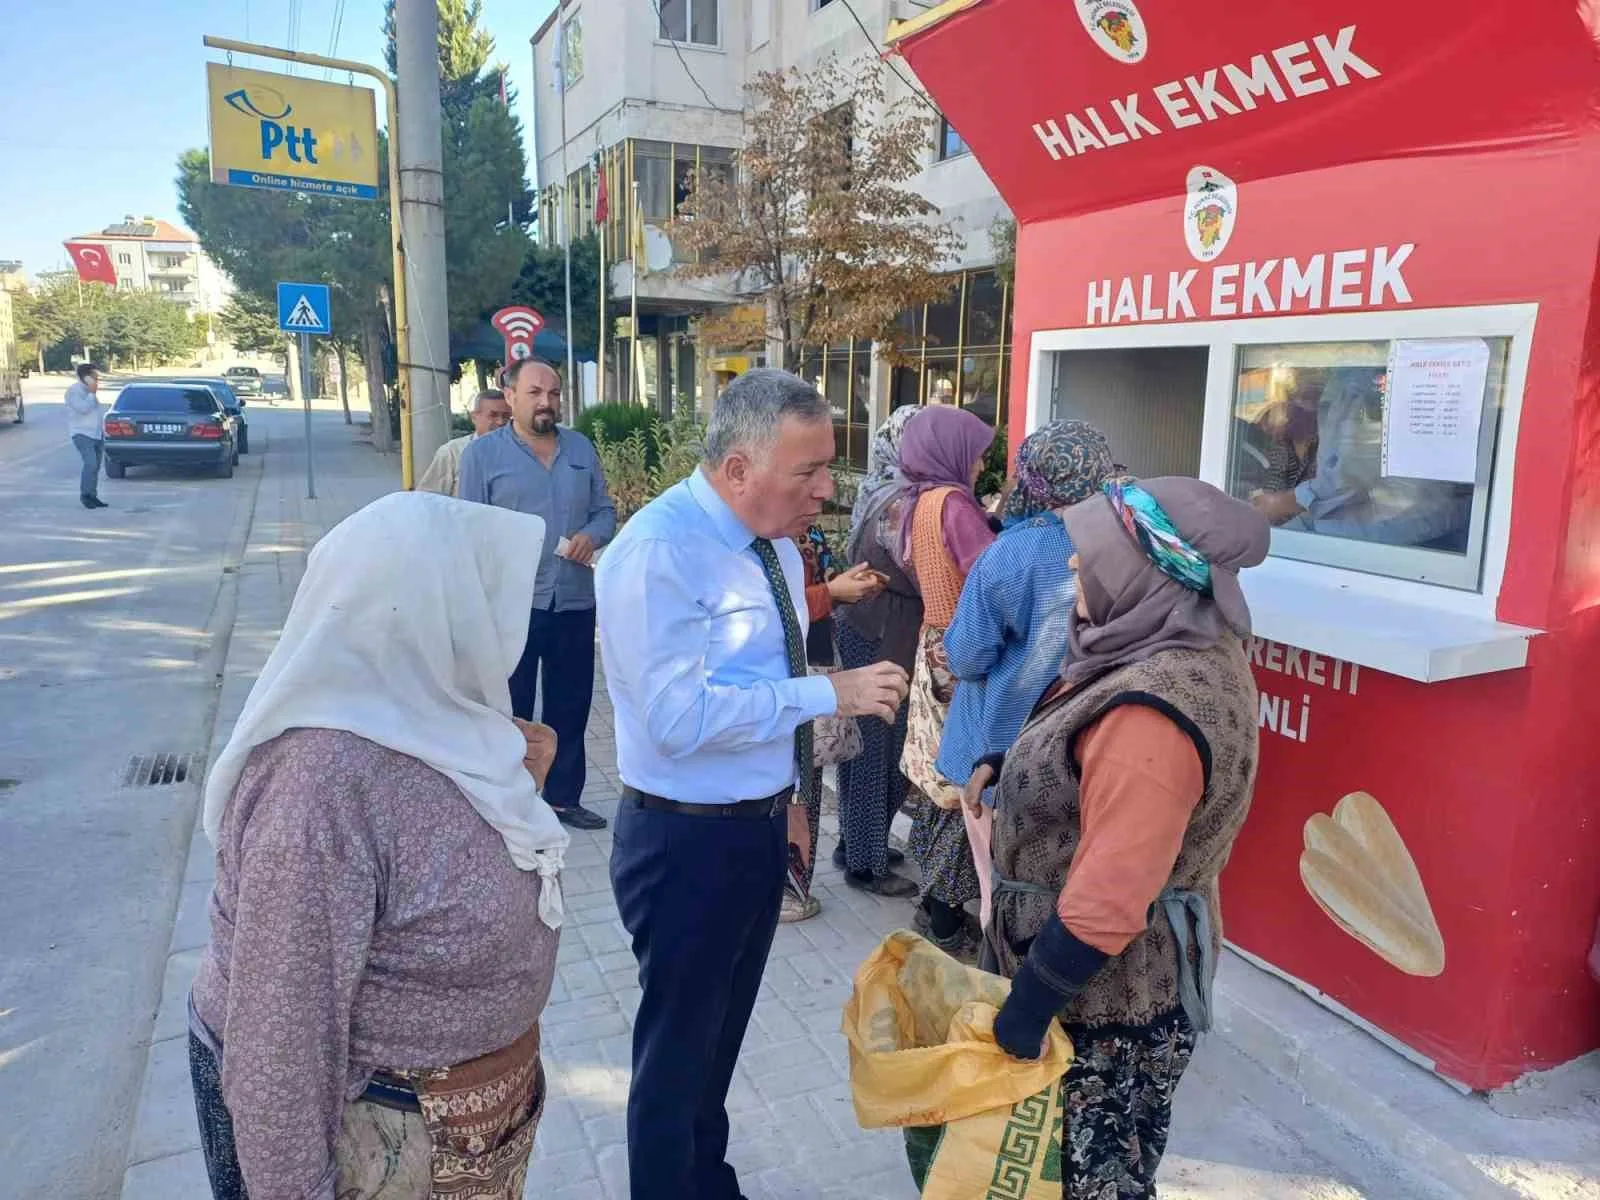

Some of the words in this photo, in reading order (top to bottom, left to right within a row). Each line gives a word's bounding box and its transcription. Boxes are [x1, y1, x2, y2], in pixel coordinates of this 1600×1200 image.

[1032, 94, 1162, 161] HALK
[1153, 25, 1381, 129] EKMEK
[260, 119, 318, 165] Ptt
[251, 173, 288, 187] Online
[290, 177, 333, 192] hizmete
[335, 184, 358, 195] açık
[1086, 269, 1200, 325] HALK
[1210, 243, 1415, 317] EKMEK
